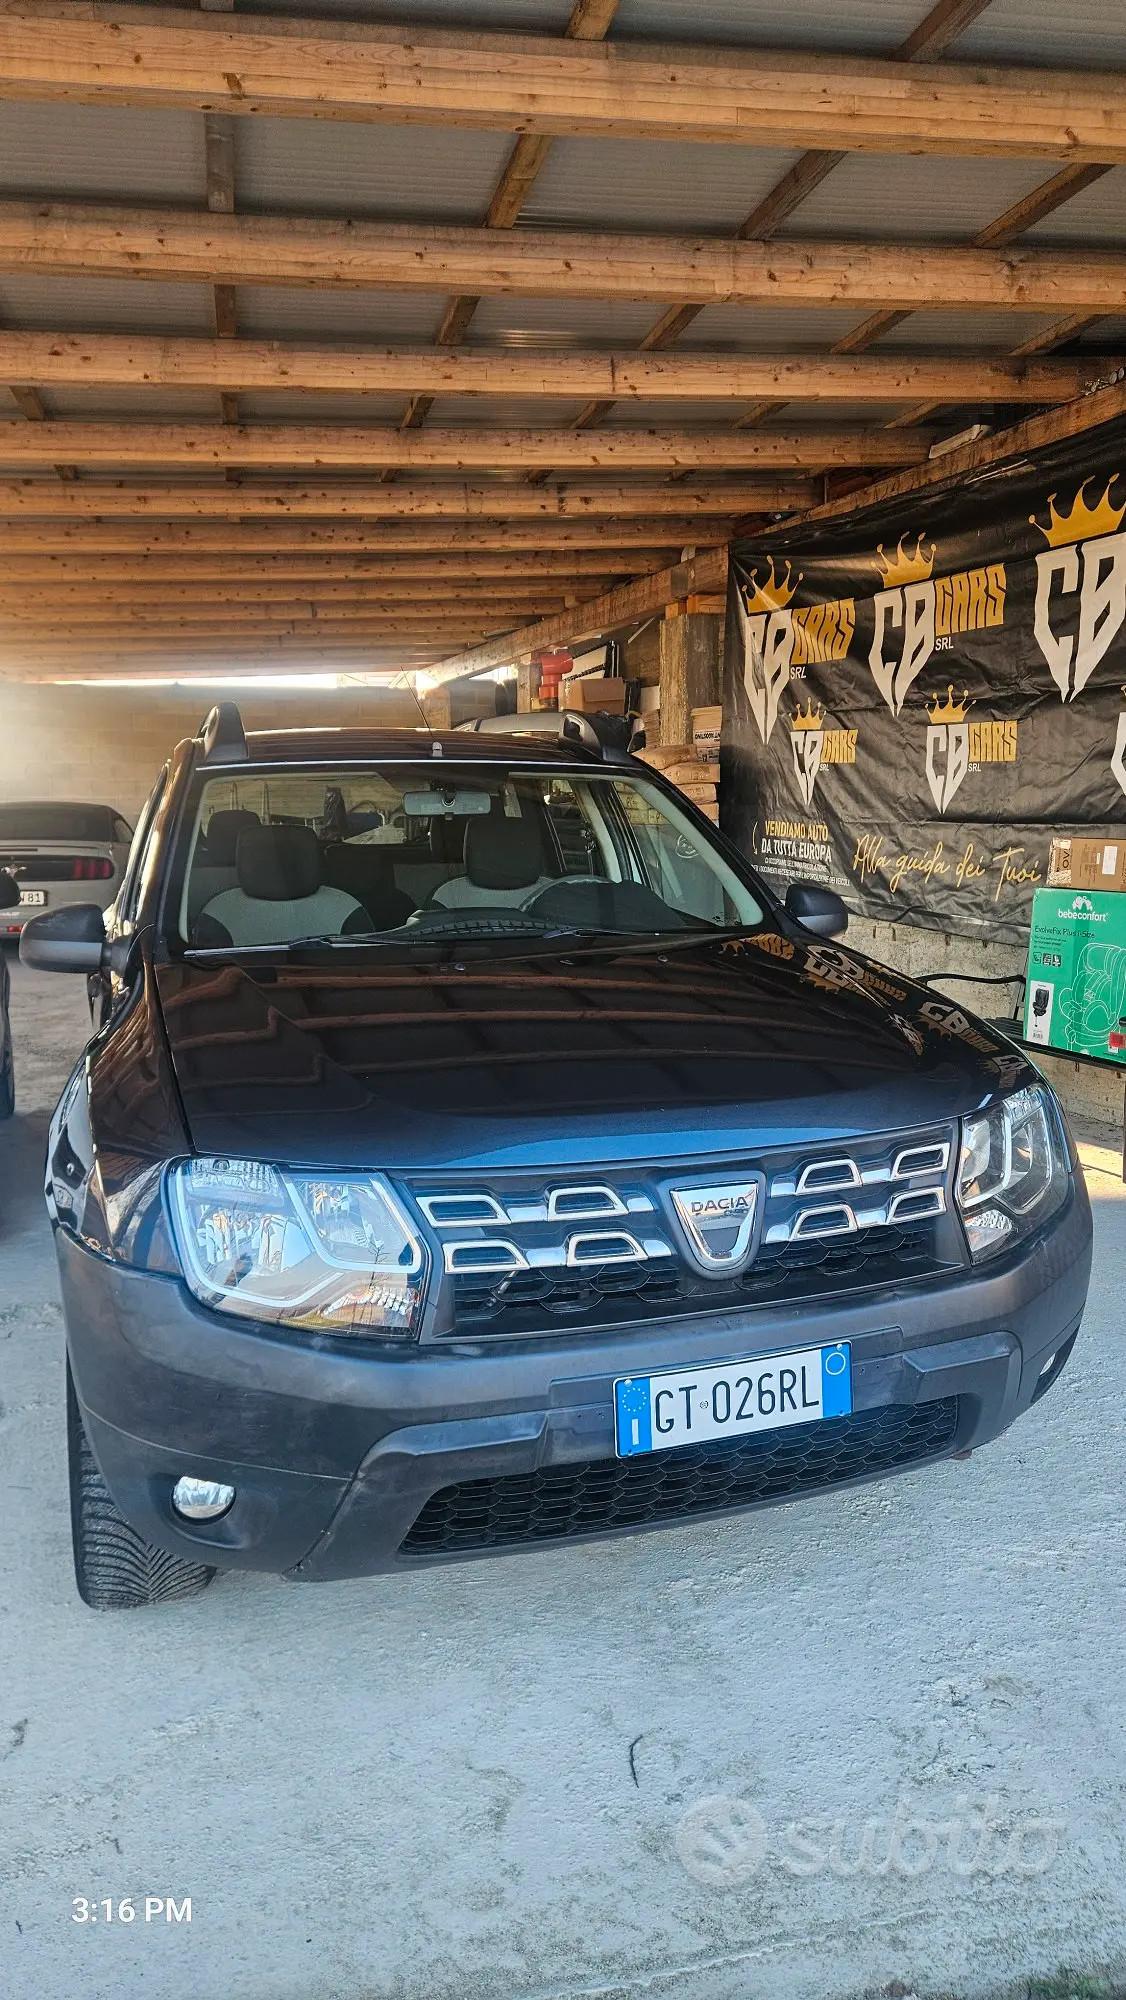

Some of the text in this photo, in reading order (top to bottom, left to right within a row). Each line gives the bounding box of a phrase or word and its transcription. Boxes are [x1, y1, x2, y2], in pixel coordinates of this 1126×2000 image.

[934, 563, 1006, 636] CARS
[791, 598, 855, 664] CARS
[935, 636, 954, 651] SRL
[790, 666, 807, 680] SRL
[820, 729, 858, 764] CARS
[968, 720, 1018, 762] CARS
[819, 763, 829, 771] SRL
[968, 762, 982, 772] SRL
[765, 820, 829, 841] VENDIAMO AUTO
[761, 838, 832, 862] DA TUTTA EUROPA
[853, 834, 1041, 902] Alla guida dei Tuoi
[1058, 909, 1107, 922] bebeconfort
[691, 1197, 748, 1213] DACIA
[655, 1365, 819, 1434] GT 026RL
